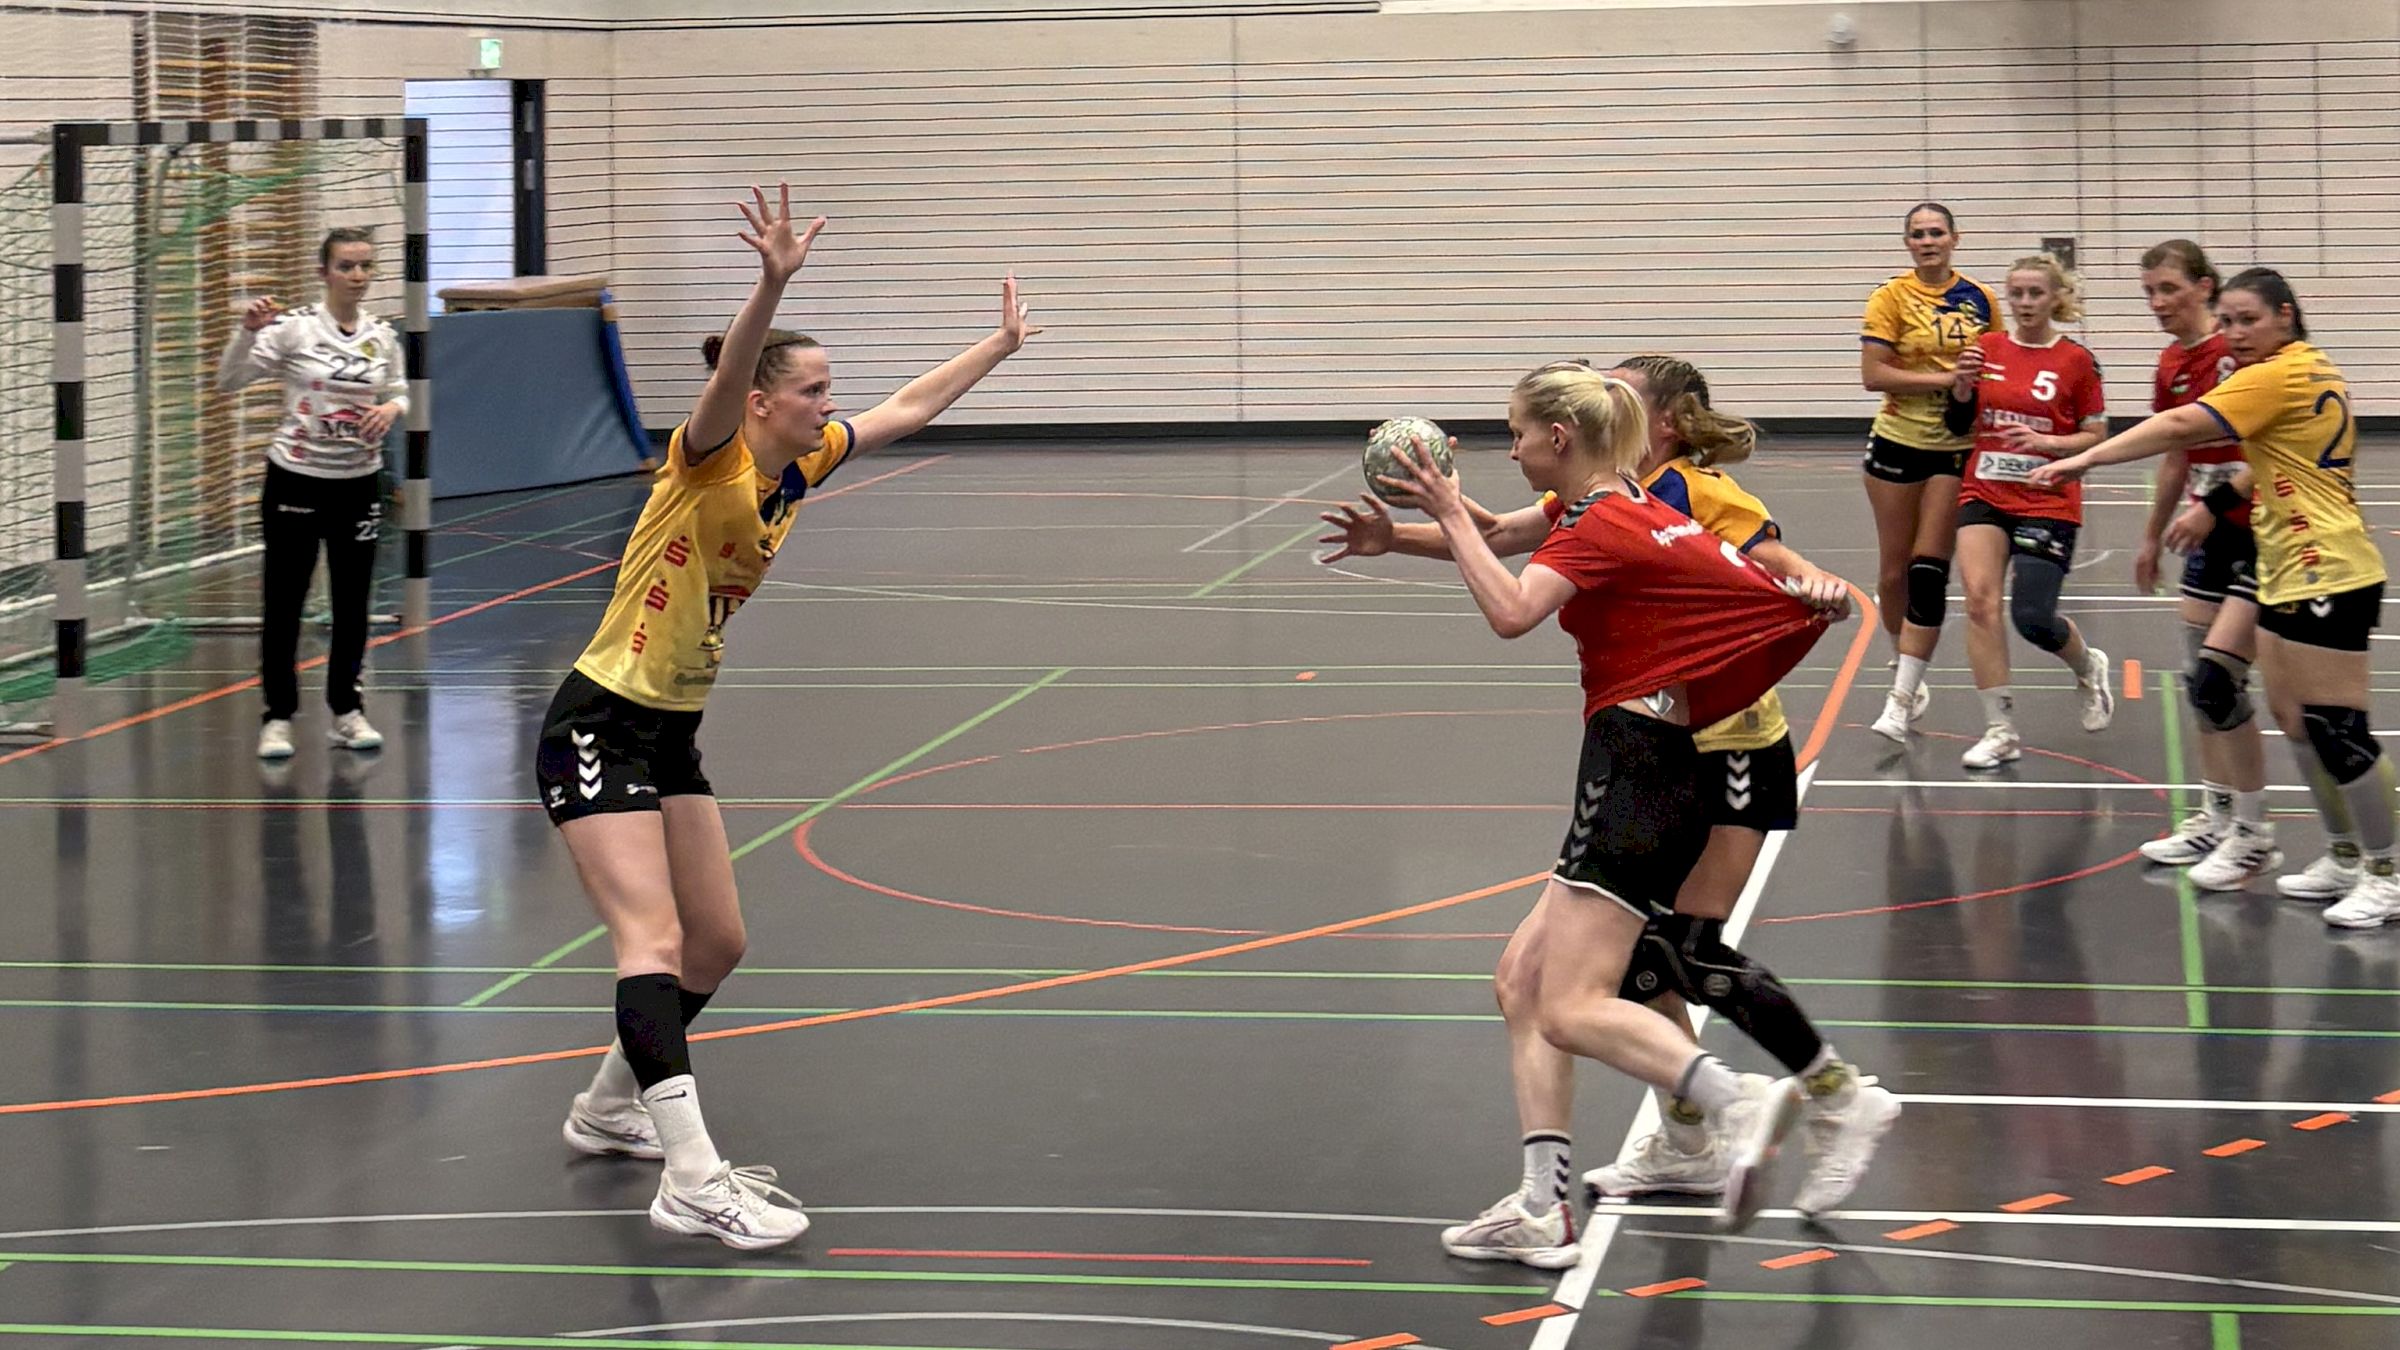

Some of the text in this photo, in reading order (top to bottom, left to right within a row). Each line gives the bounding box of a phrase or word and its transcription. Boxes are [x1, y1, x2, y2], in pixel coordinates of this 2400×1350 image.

[1931, 317, 1968, 347] 14
[329, 355, 373, 384] 22
[2030, 369, 2059, 401] 5
[2315, 390, 2352, 469] 2
